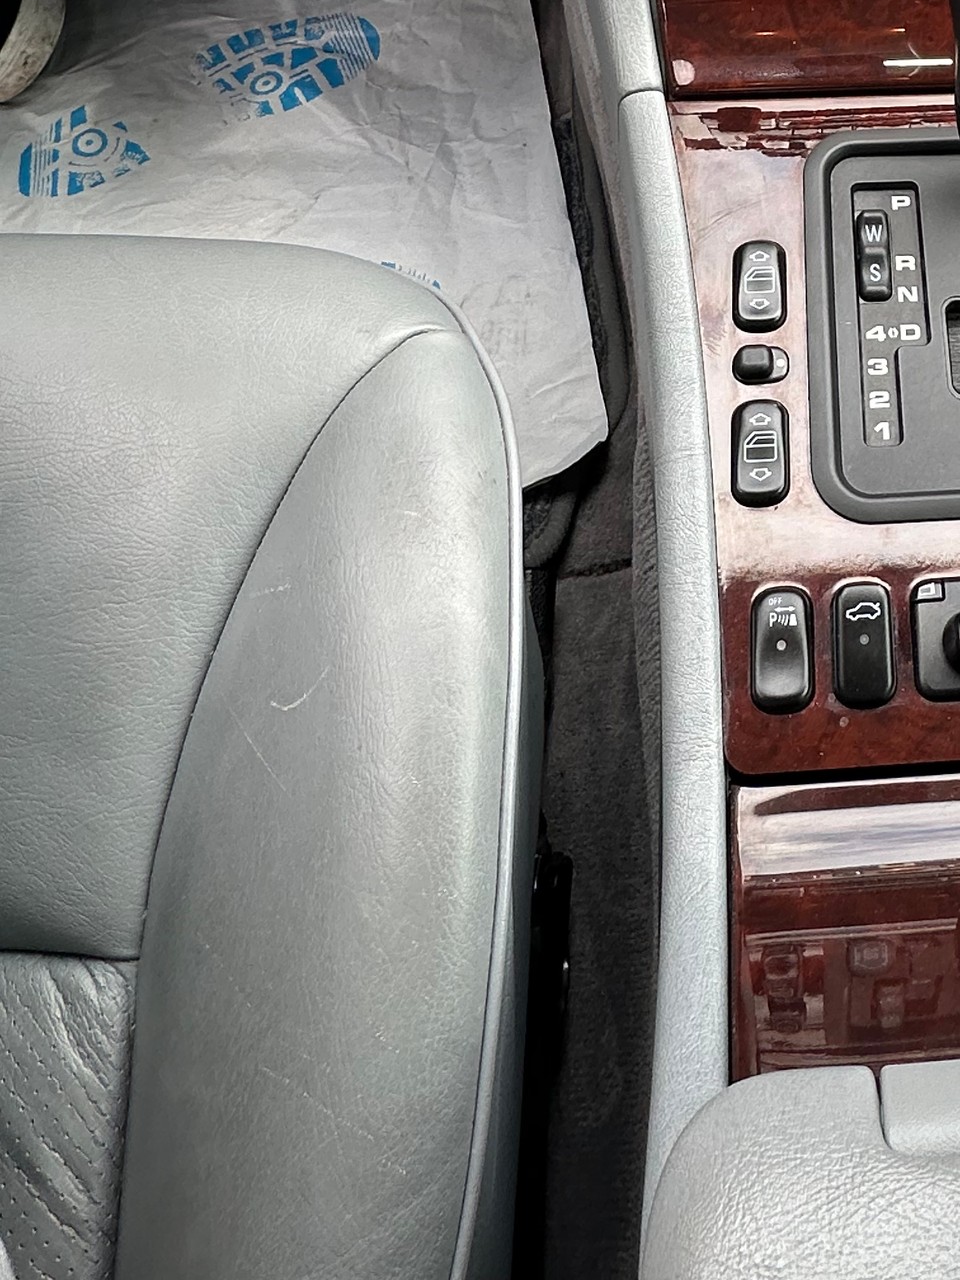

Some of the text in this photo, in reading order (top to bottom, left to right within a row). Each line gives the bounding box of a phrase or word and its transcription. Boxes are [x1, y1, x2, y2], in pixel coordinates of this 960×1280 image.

[891, 195, 911, 210] P
[865, 225, 882, 243] W
[895, 255, 916, 271] R
[869, 264, 882, 282] S
[897, 286, 918, 303] N
[867, 358, 888, 375] 3
[869, 391, 890, 409] 2
[873, 422, 890, 440] 1
[768, 596, 783, 606] OFF
